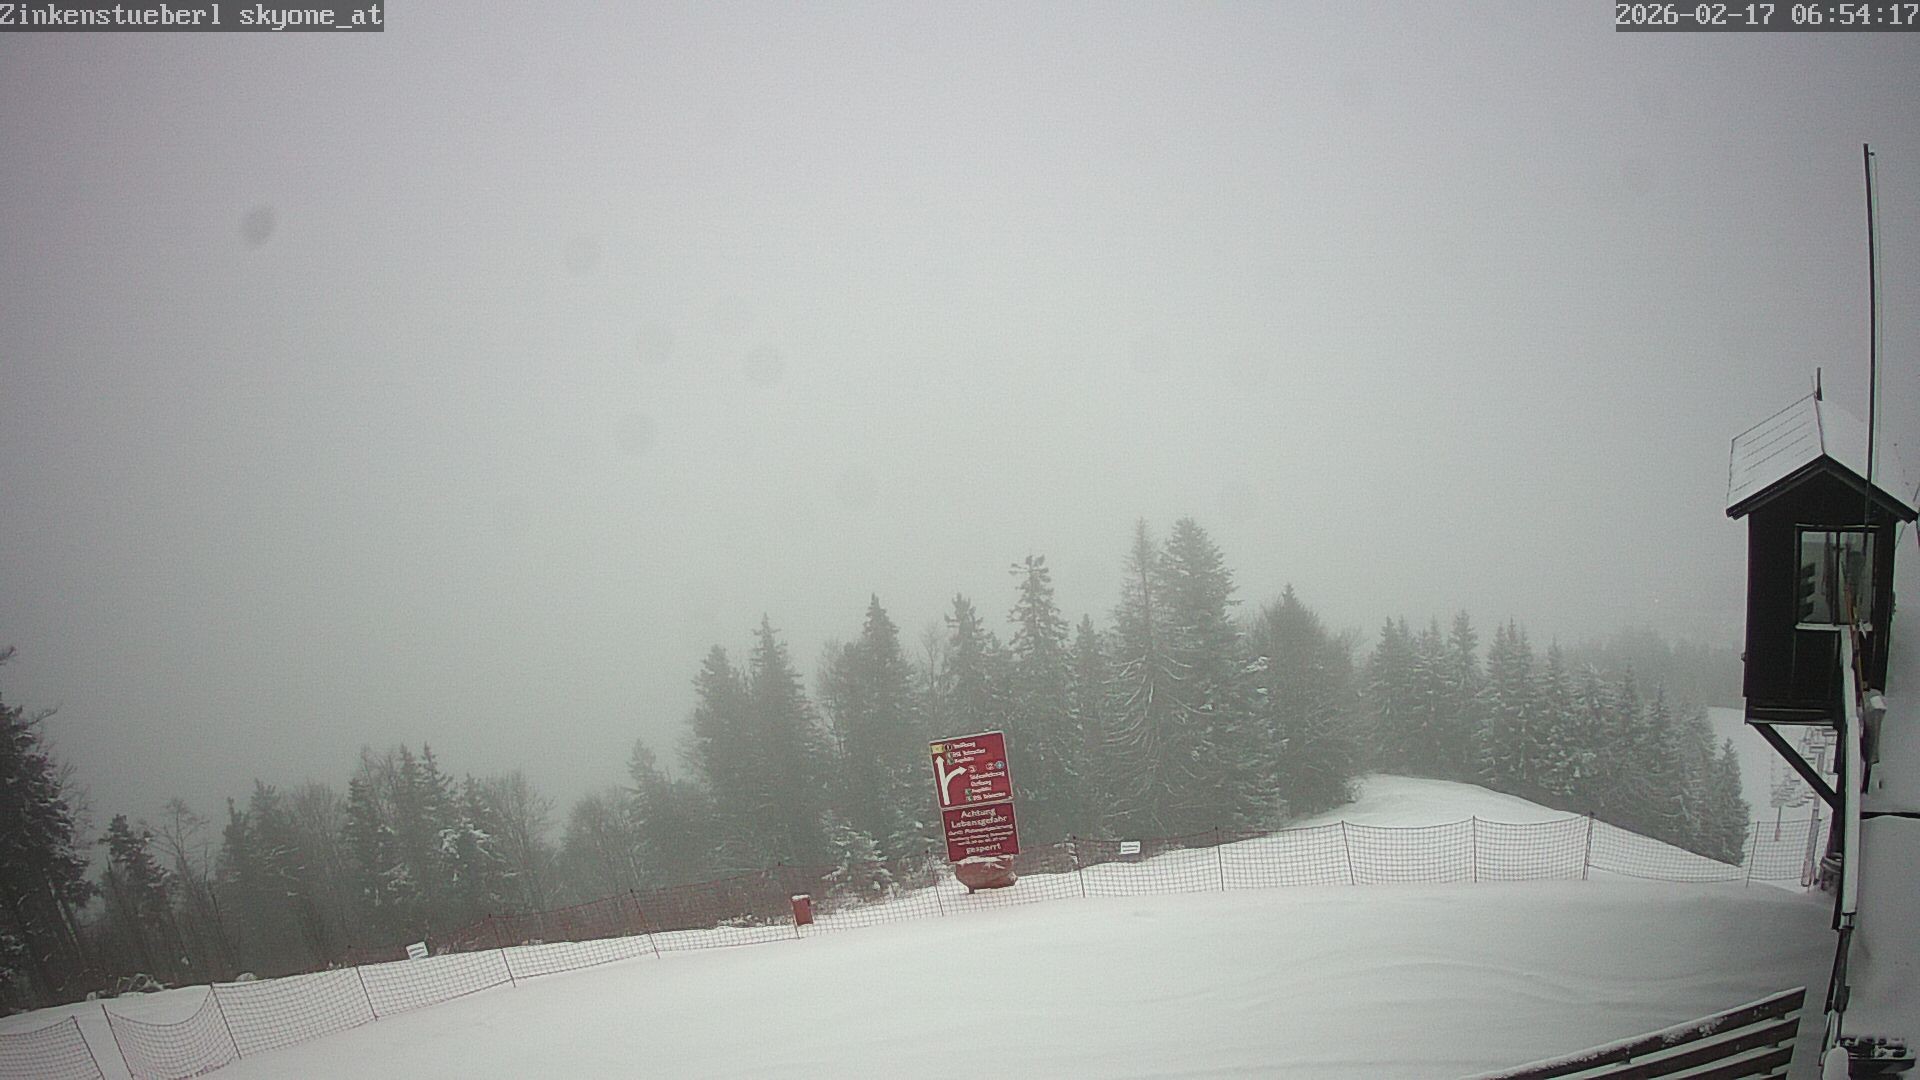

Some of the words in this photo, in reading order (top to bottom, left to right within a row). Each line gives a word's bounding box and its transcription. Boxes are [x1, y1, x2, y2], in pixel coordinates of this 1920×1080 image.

[961, 808, 996, 819] Achtung
[951, 815, 1008, 829] Lebensgefahr
[966, 842, 1002, 854] gesperrt
